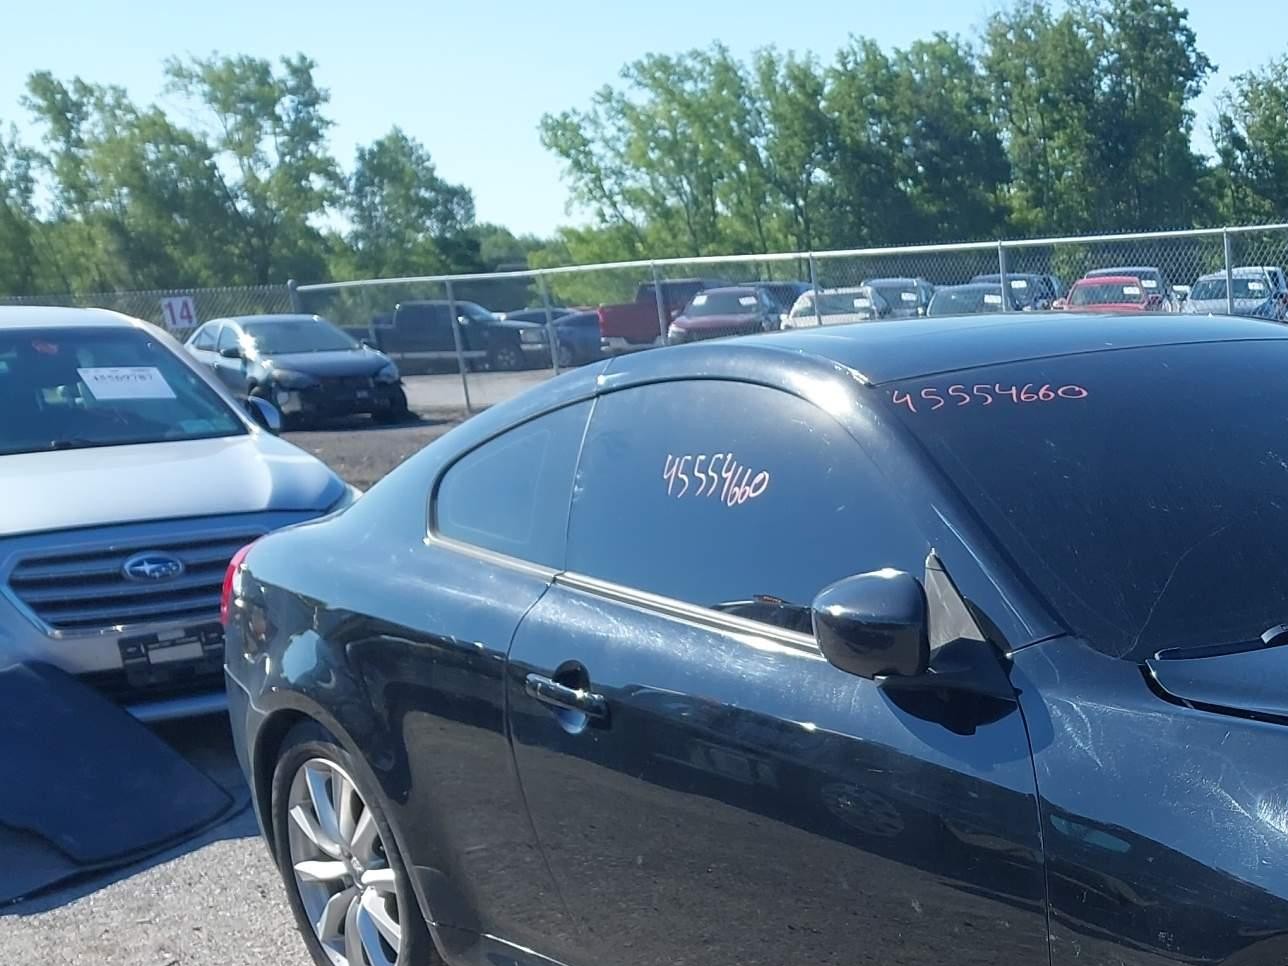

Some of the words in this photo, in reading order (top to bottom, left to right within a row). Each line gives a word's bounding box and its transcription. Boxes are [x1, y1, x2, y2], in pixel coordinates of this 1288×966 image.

[164, 300, 193, 326] 14
[893, 383, 1089, 413] 45554660
[663, 453, 770, 507] 45554660
